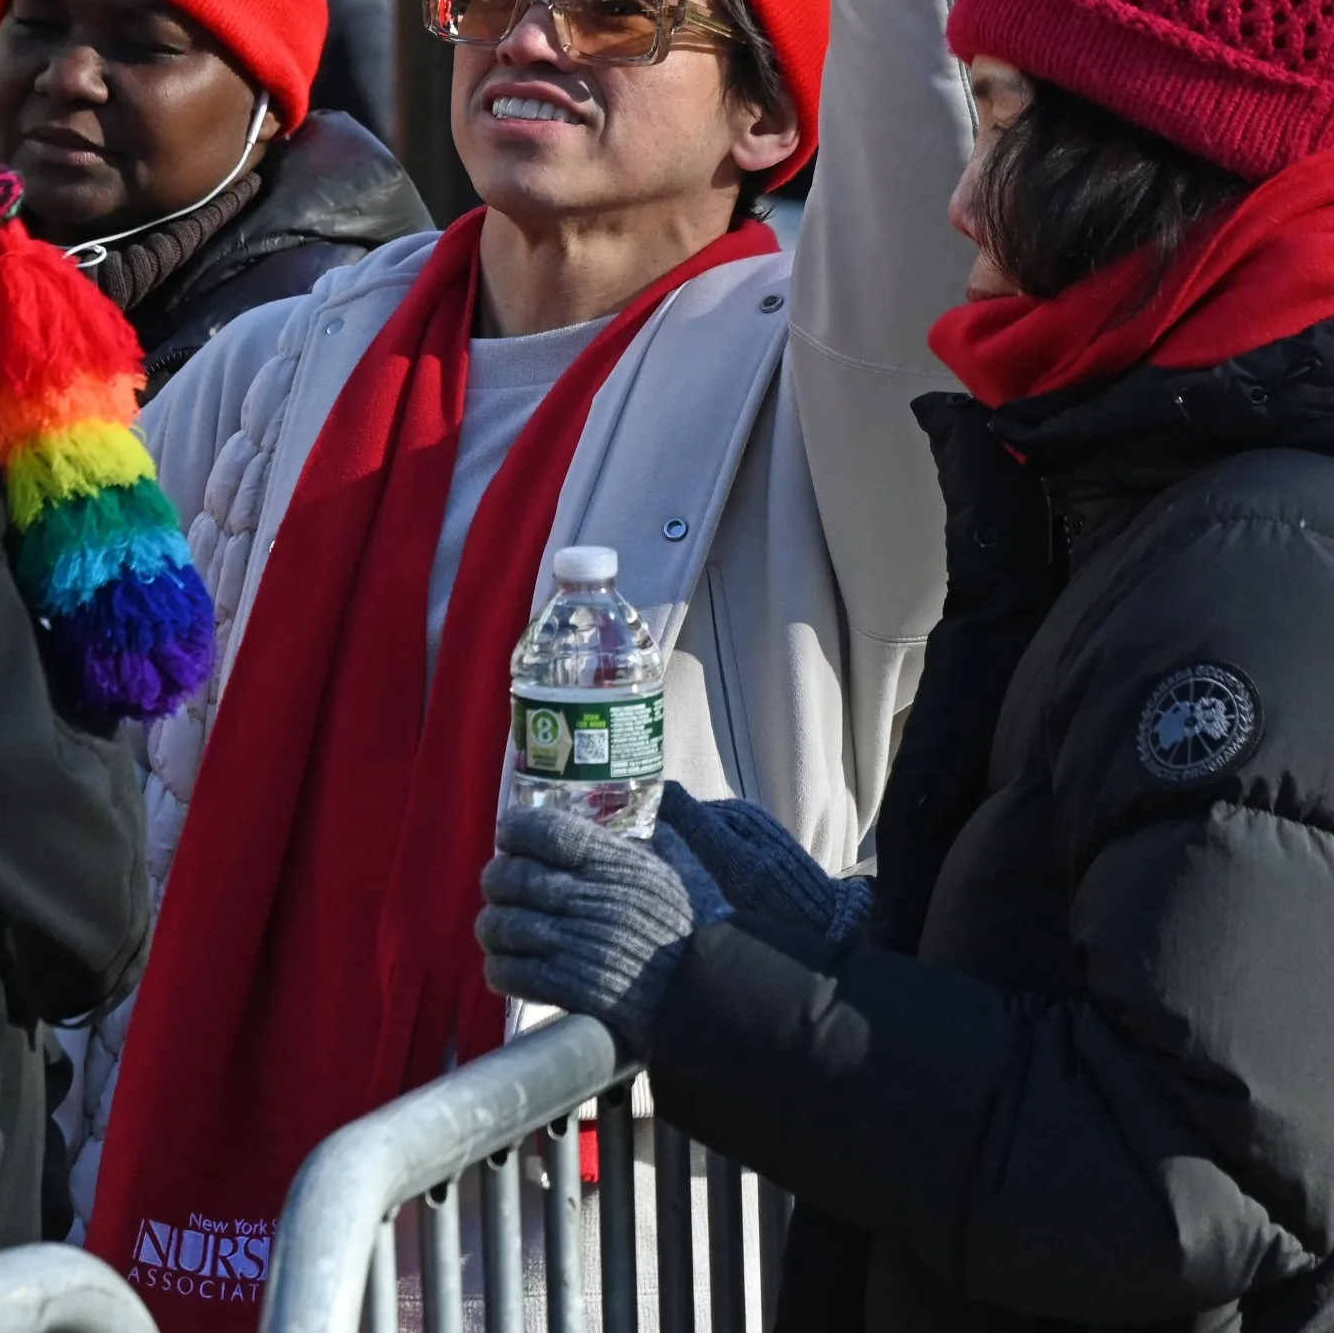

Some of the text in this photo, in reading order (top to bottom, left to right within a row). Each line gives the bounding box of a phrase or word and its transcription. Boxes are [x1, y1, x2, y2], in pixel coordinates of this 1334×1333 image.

[189, 1212, 228, 1234] New
[234, 1218, 267, 1235] York
[133, 1218, 271, 1281] NURS
[127, 1266, 260, 1303] ASSOCIAT
